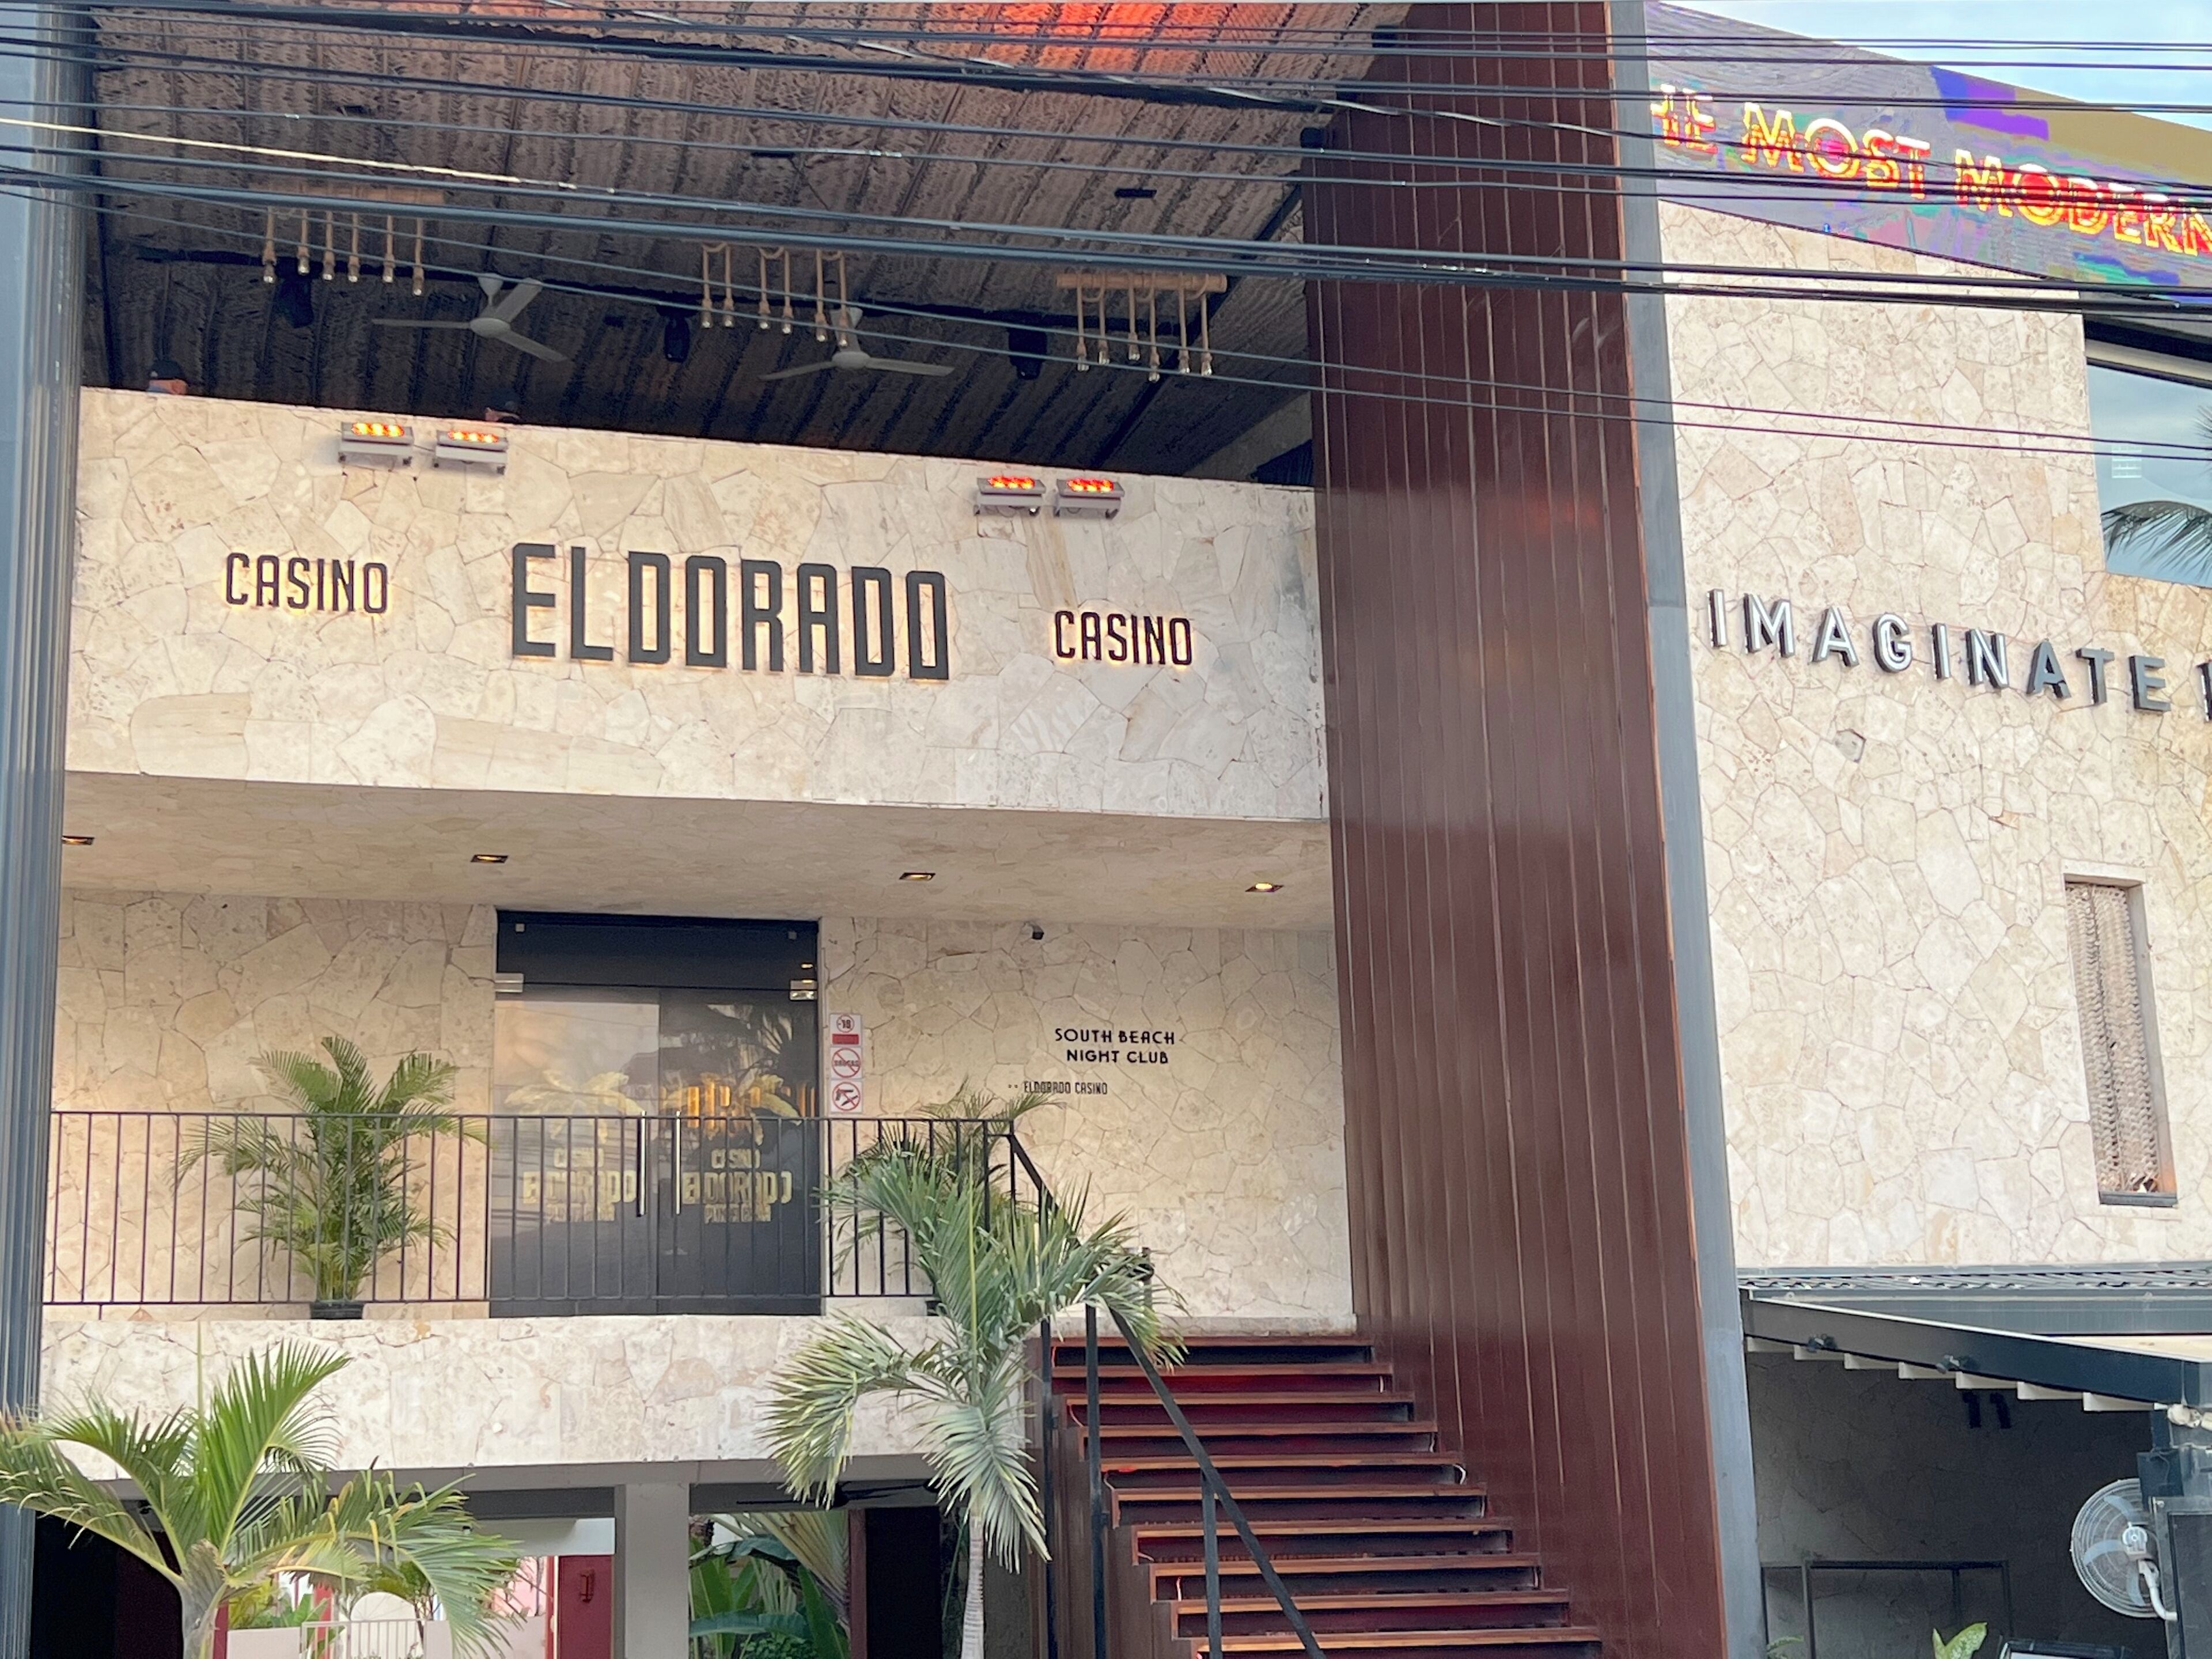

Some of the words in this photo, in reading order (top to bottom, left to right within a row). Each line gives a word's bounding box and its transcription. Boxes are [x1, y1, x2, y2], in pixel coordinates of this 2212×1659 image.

[1741, 102, 1931, 200] MOST
[225, 552, 388, 614] CASINO
[512, 542, 949, 681] ELDORADO
[1055, 609, 1193, 666] CASINO
[1706, 588, 2171, 714] IMAGINATE
[1055, 1028, 1112, 1043] SOUTH
[1118, 1030, 1175, 1045] BEACH
[1066, 1049, 1120, 1063] NIGHT
[1127, 1051, 1168, 1065] CLUB
[1024, 1081, 1071, 1094] ELDORADO
[1075, 1082, 1108, 1095] CASINO
